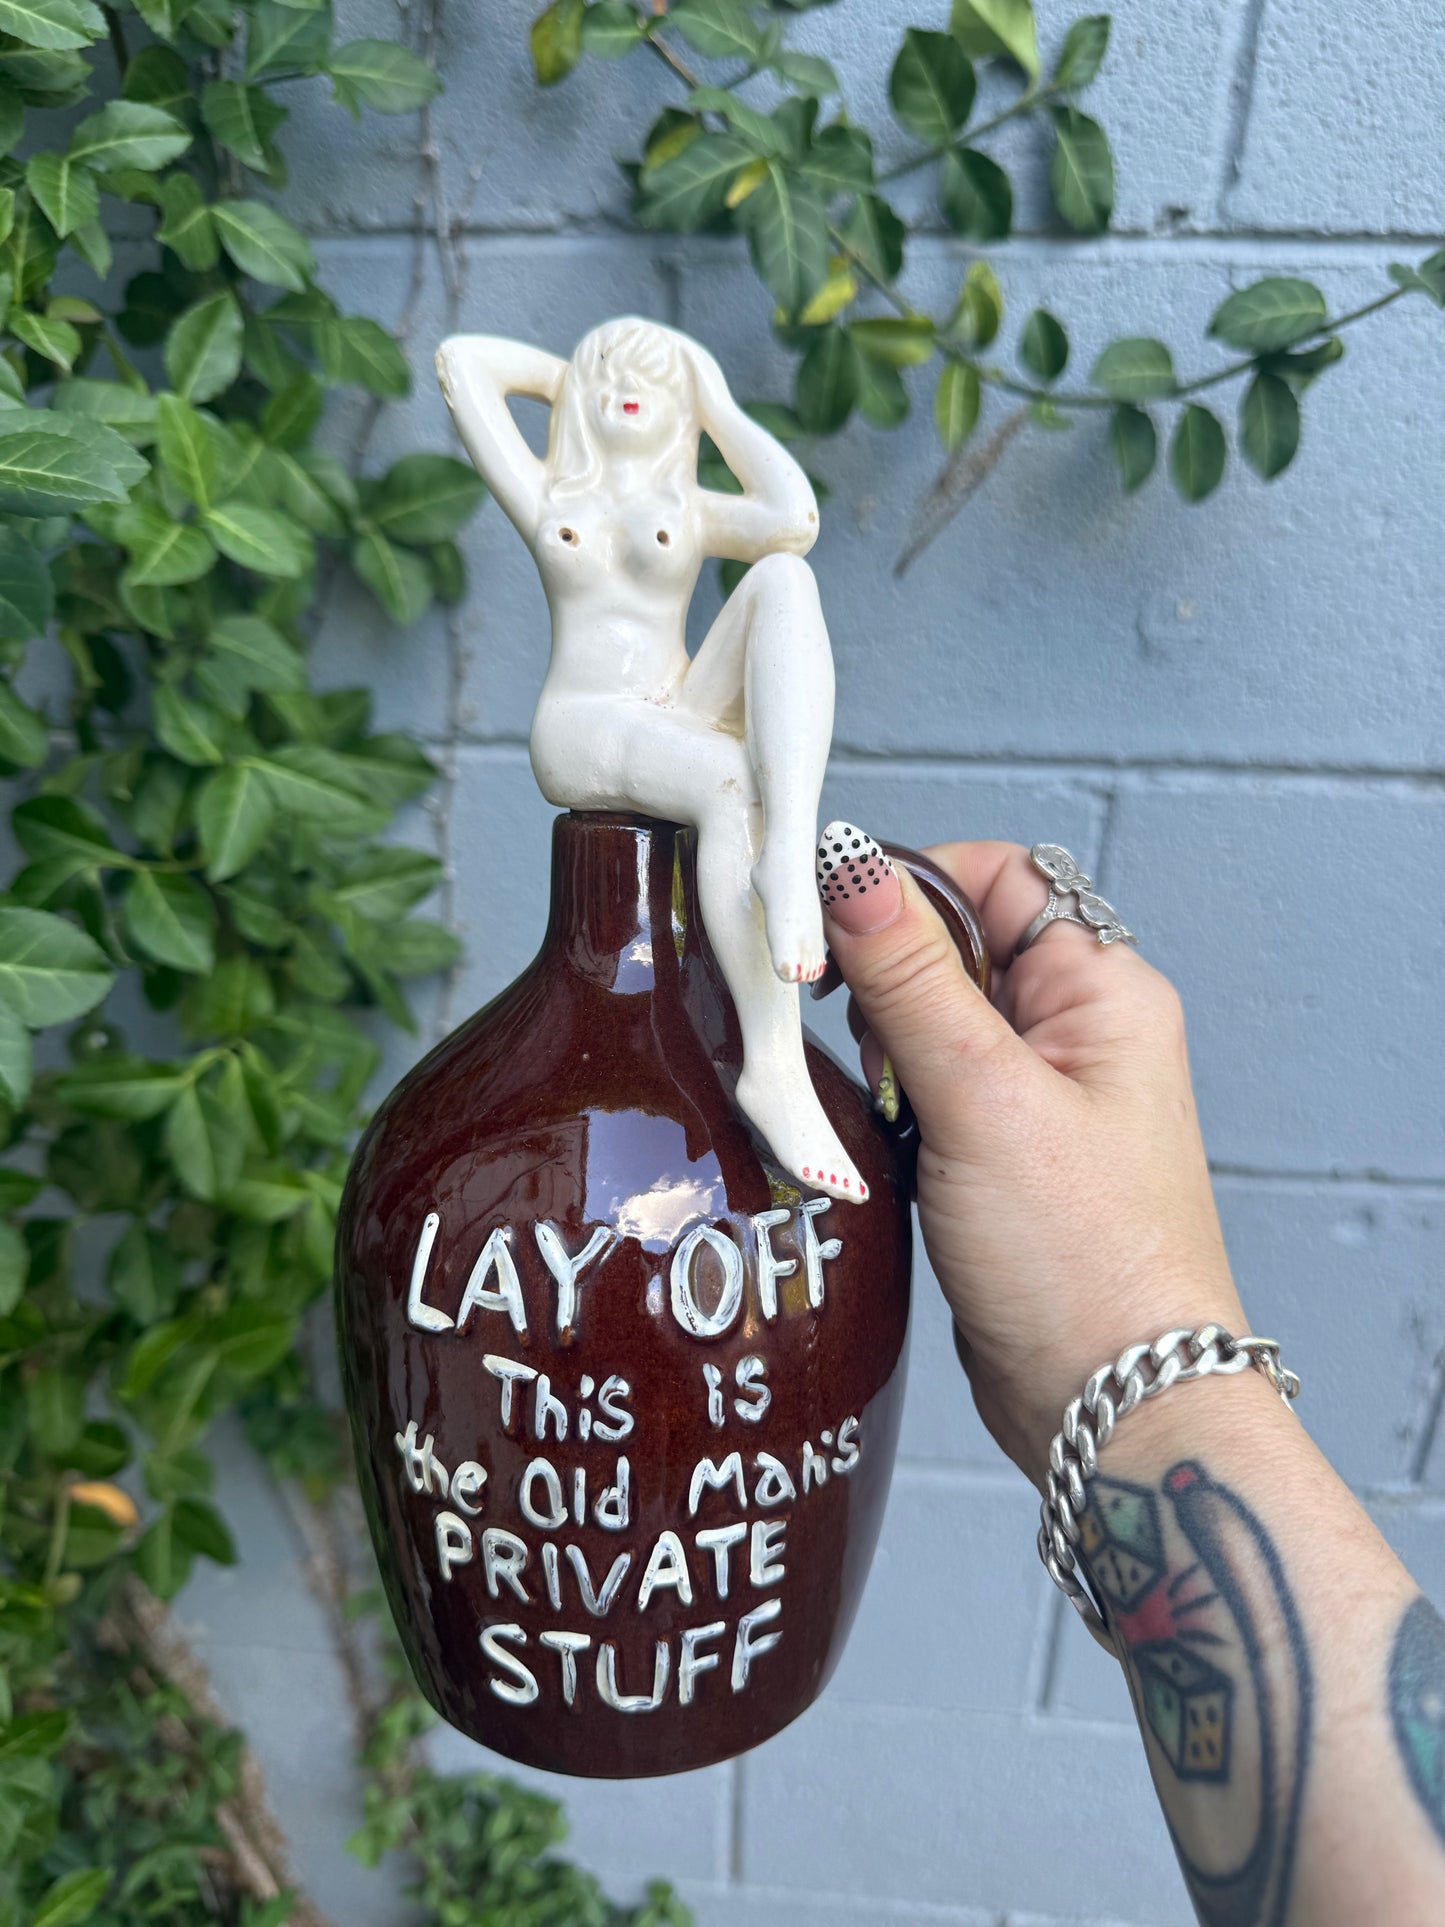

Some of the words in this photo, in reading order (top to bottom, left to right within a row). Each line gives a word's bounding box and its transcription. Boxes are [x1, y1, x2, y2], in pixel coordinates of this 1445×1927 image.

[407, 1212, 615, 1345] LAY
[670, 1197, 843, 1337] OFF
[482, 1353, 636, 1442] This
[702, 1355, 772, 1427] is
[395, 1419, 488, 1515] the
[519, 1455, 630, 1531] Old
[434, 1510, 787, 1616] PRIVATE
[479, 1597, 783, 1712] STUFF
